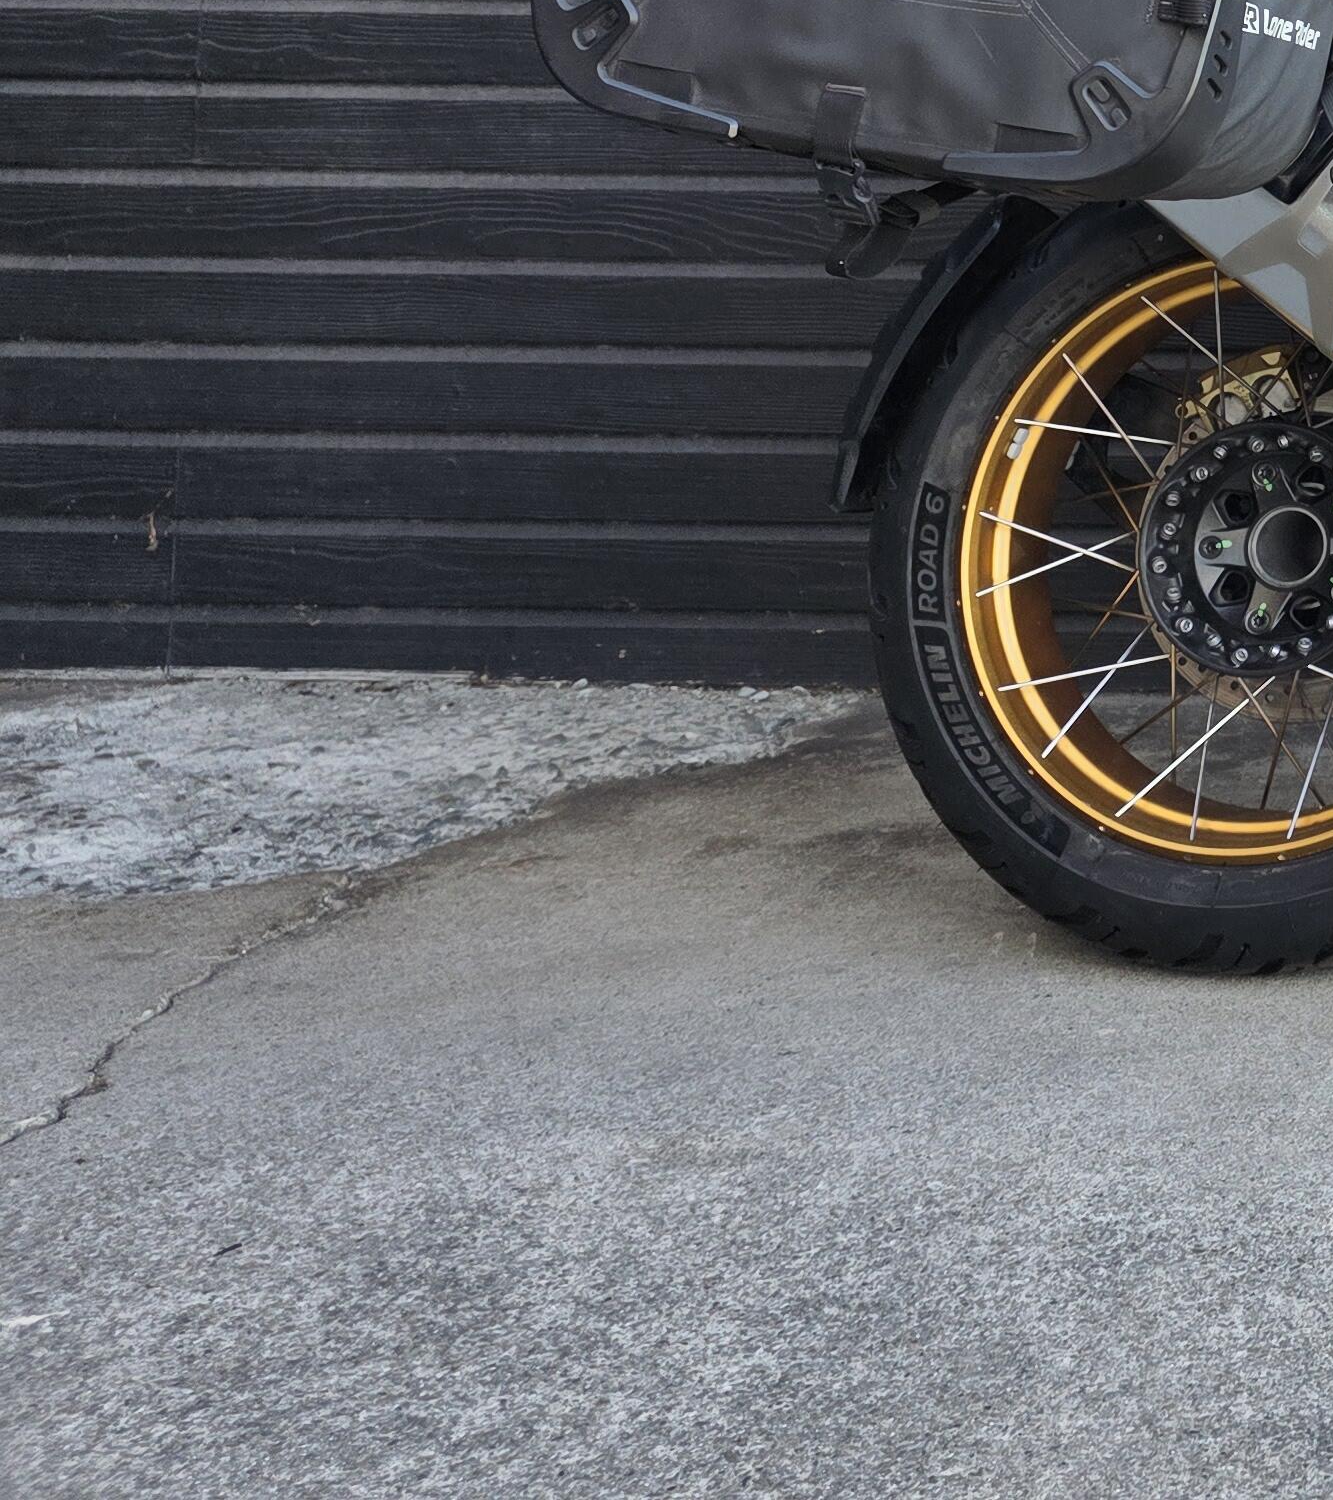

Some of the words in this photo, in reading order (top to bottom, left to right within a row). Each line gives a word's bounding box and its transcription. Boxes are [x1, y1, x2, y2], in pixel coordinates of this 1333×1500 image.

[925, 492, 945, 514] 6
[917, 524, 940, 613] ROAD
[924, 644, 1023, 804] MICHELIN
